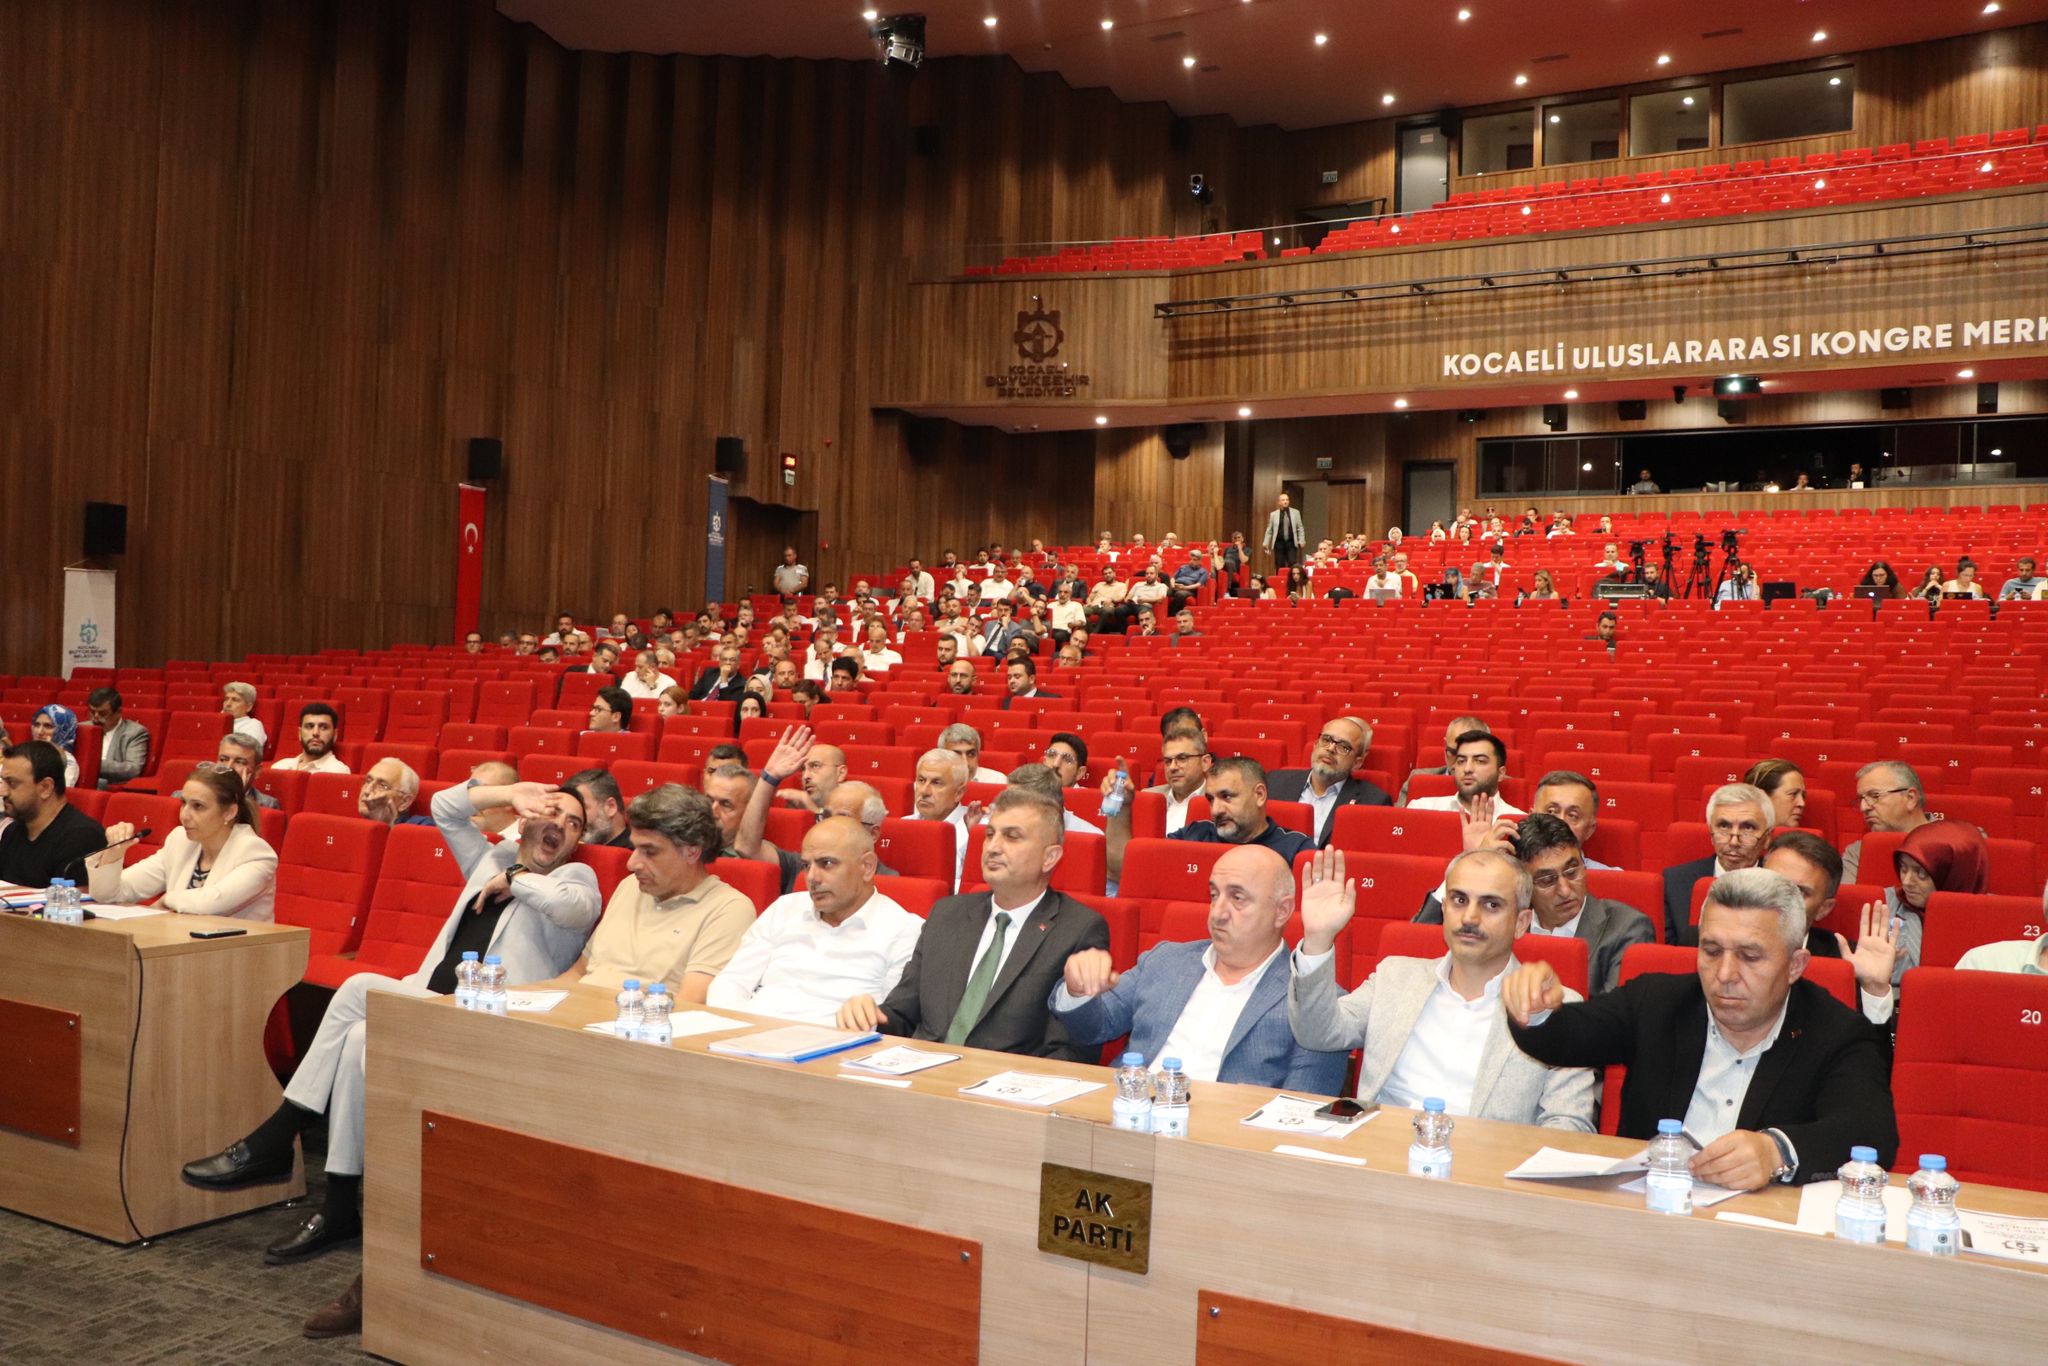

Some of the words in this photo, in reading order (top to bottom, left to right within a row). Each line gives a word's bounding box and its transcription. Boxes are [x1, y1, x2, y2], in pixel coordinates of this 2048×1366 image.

[1443, 342, 1564, 376] KOCAELİ
[1573, 334, 1800, 370] ULUSLARARASI
[1811, 323, 1952, 356] KONGRE
[1672, 727, 1681, 735] 21
[1781, 731, 1791, 739] 22
[1898, 736, 1908, 744] 23
[2024, 739, 2035, 748] 24
[1129, 746, 1138, 754] 17
[1576, 742, 1585, 750] 21
[1691, 749, 1700, 757] 22
[1817, 753, 1828, 762] 23
[1948, 759, 1959, 768] 24
[1591, 767, 1601, 776] 21
[1727, 773, 1737, 782] 22
[2030, 786, 2042, 795] 24
[1607, 798, 1616, 807] 21
[1933, 812, 1945, 821] 23
[1392, 826, 1403, 836] 20
[880, 838, 891, 848] 17
[435, 848, 443, 857] 12
[1187, 864, 1198, 874] 19
[1361, 878, 1374, 888] 20
[2022, 924, 2041, 937] 23
[2021, 1010, 2041, 1024] 20
[1075, 1188, 1114, 1218] AK
[1053, 1214, 1132, 1252] PARTİ
